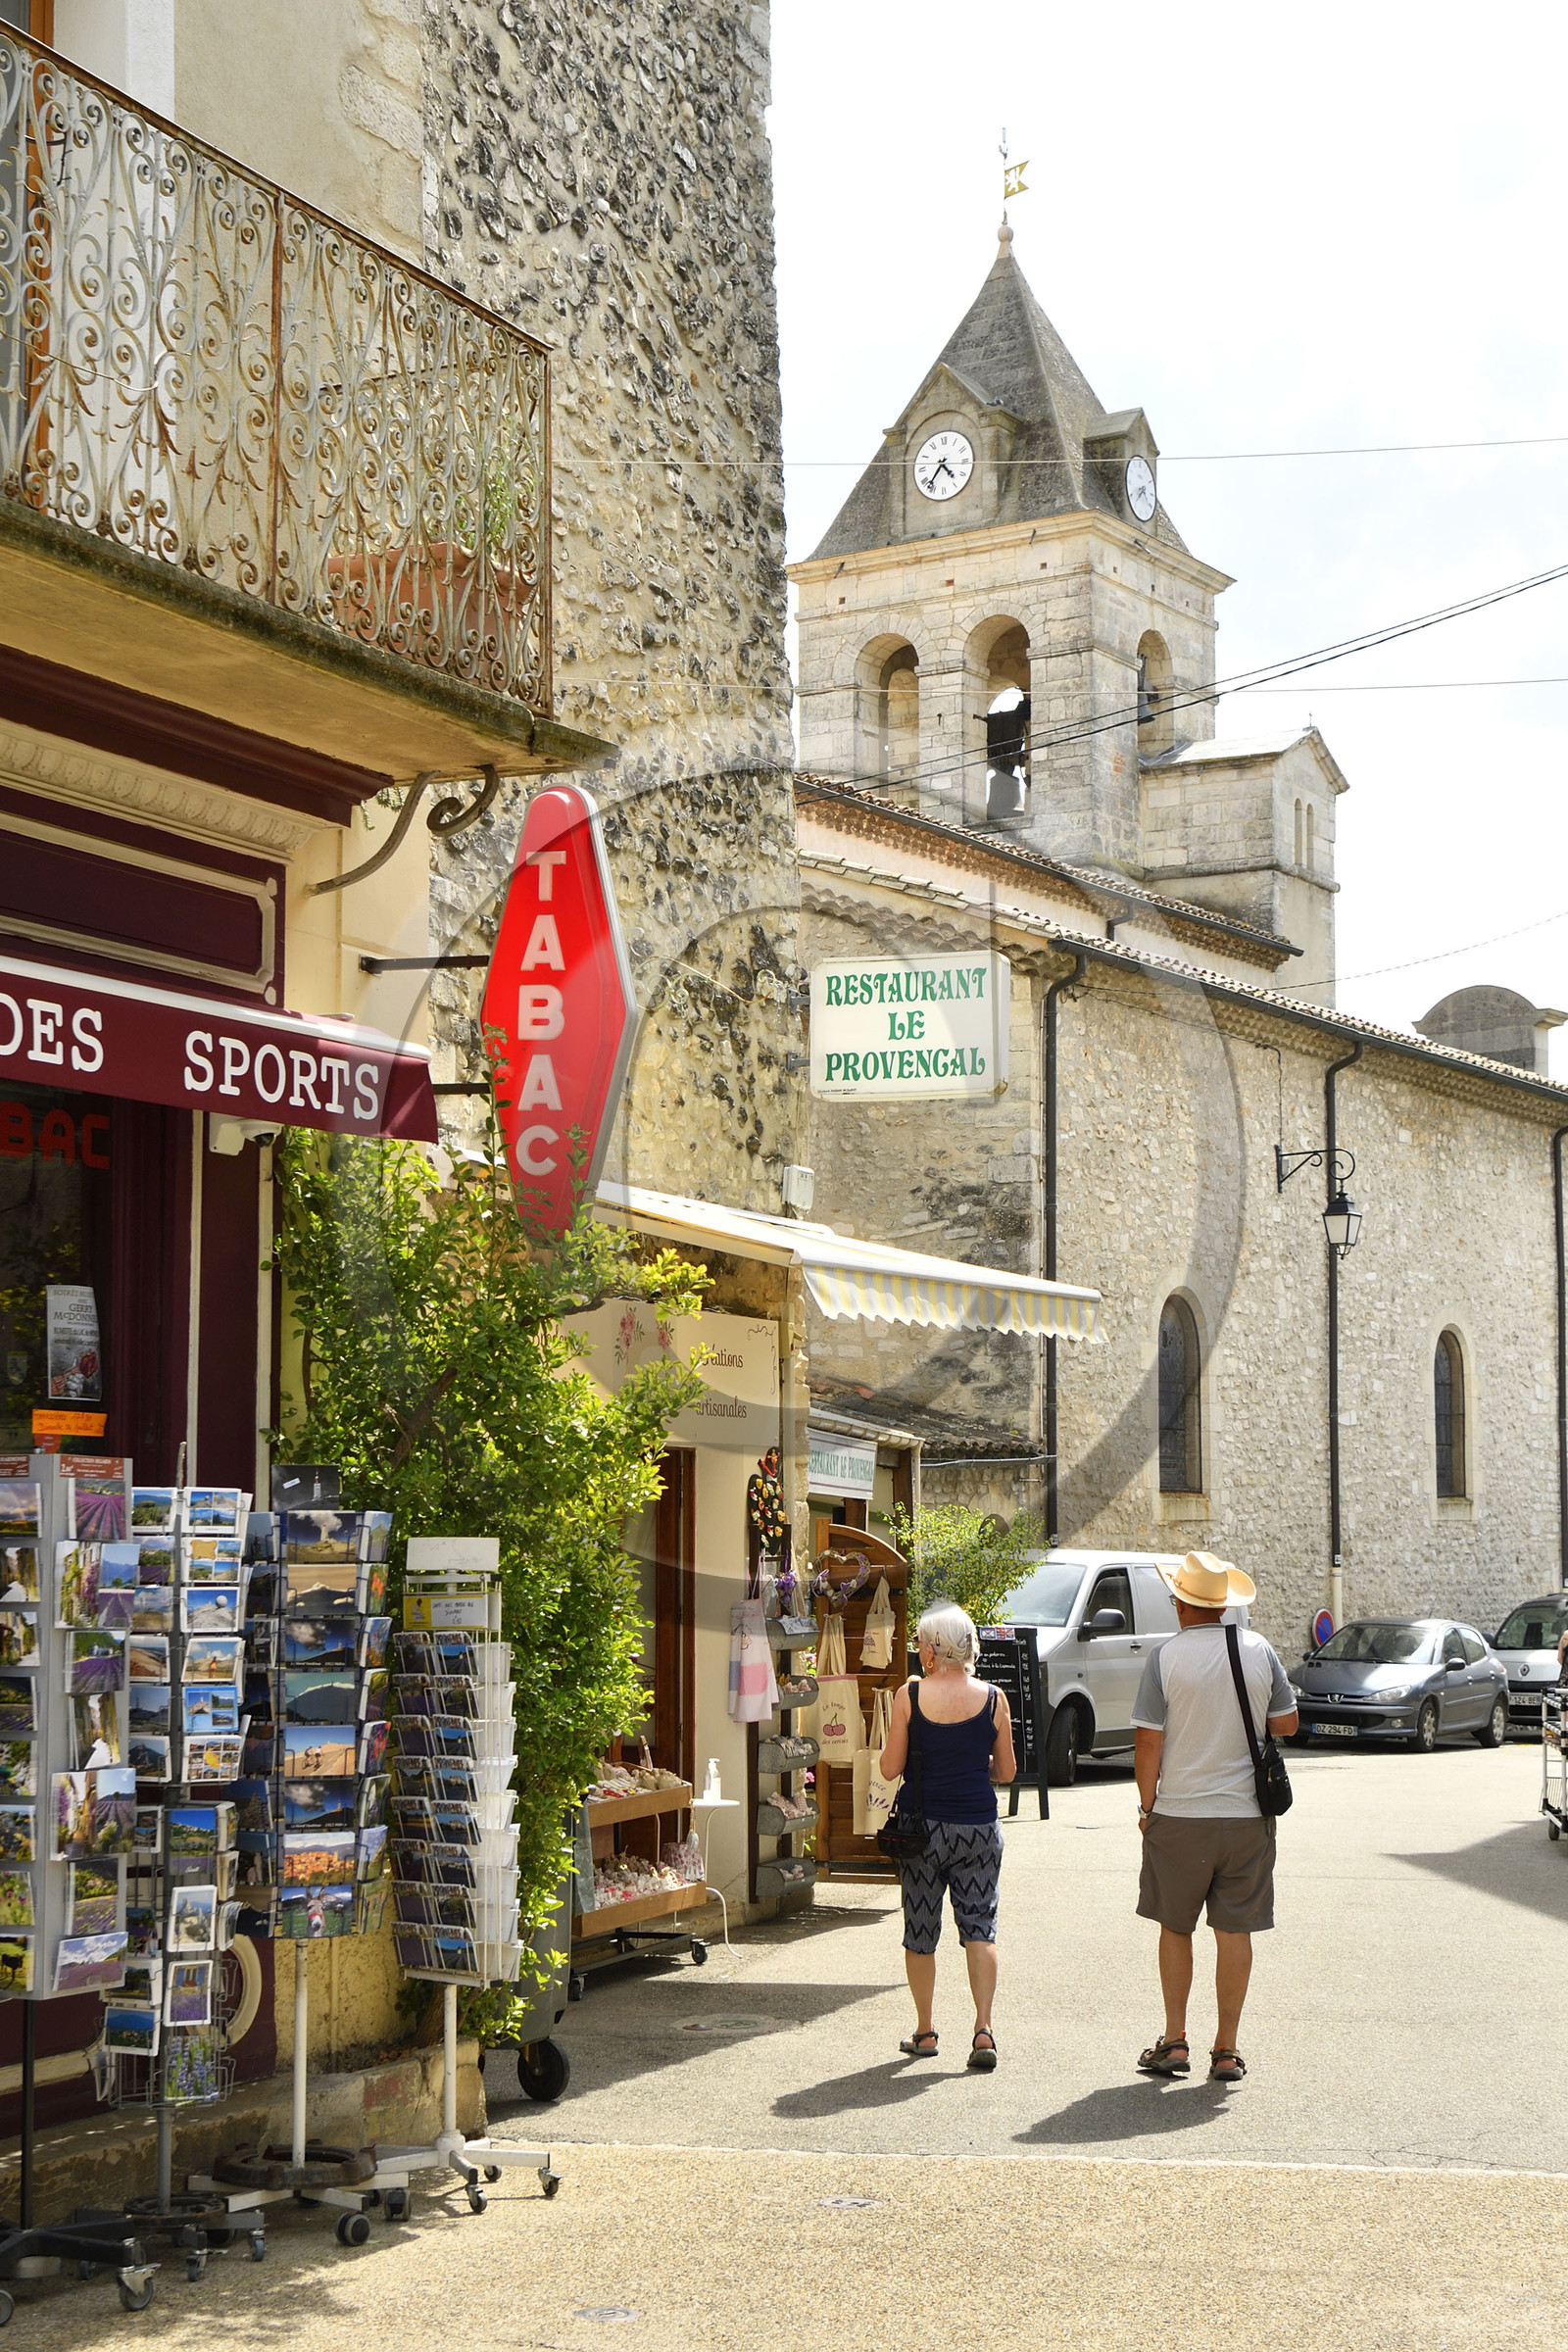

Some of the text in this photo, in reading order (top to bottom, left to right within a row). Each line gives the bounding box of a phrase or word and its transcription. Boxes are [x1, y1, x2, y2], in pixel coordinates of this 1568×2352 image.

[825, 967, 987, 1007] RESTAURANT
[515, 851, 567, 1177] TABAC
[888, 1010, 925, 1041] LE
[183, 1030, 380, 1121] SPORTS
[825, 1047, 986, 1082] PROVENCAL
[696, 1396, 748, 1419] artisanales
